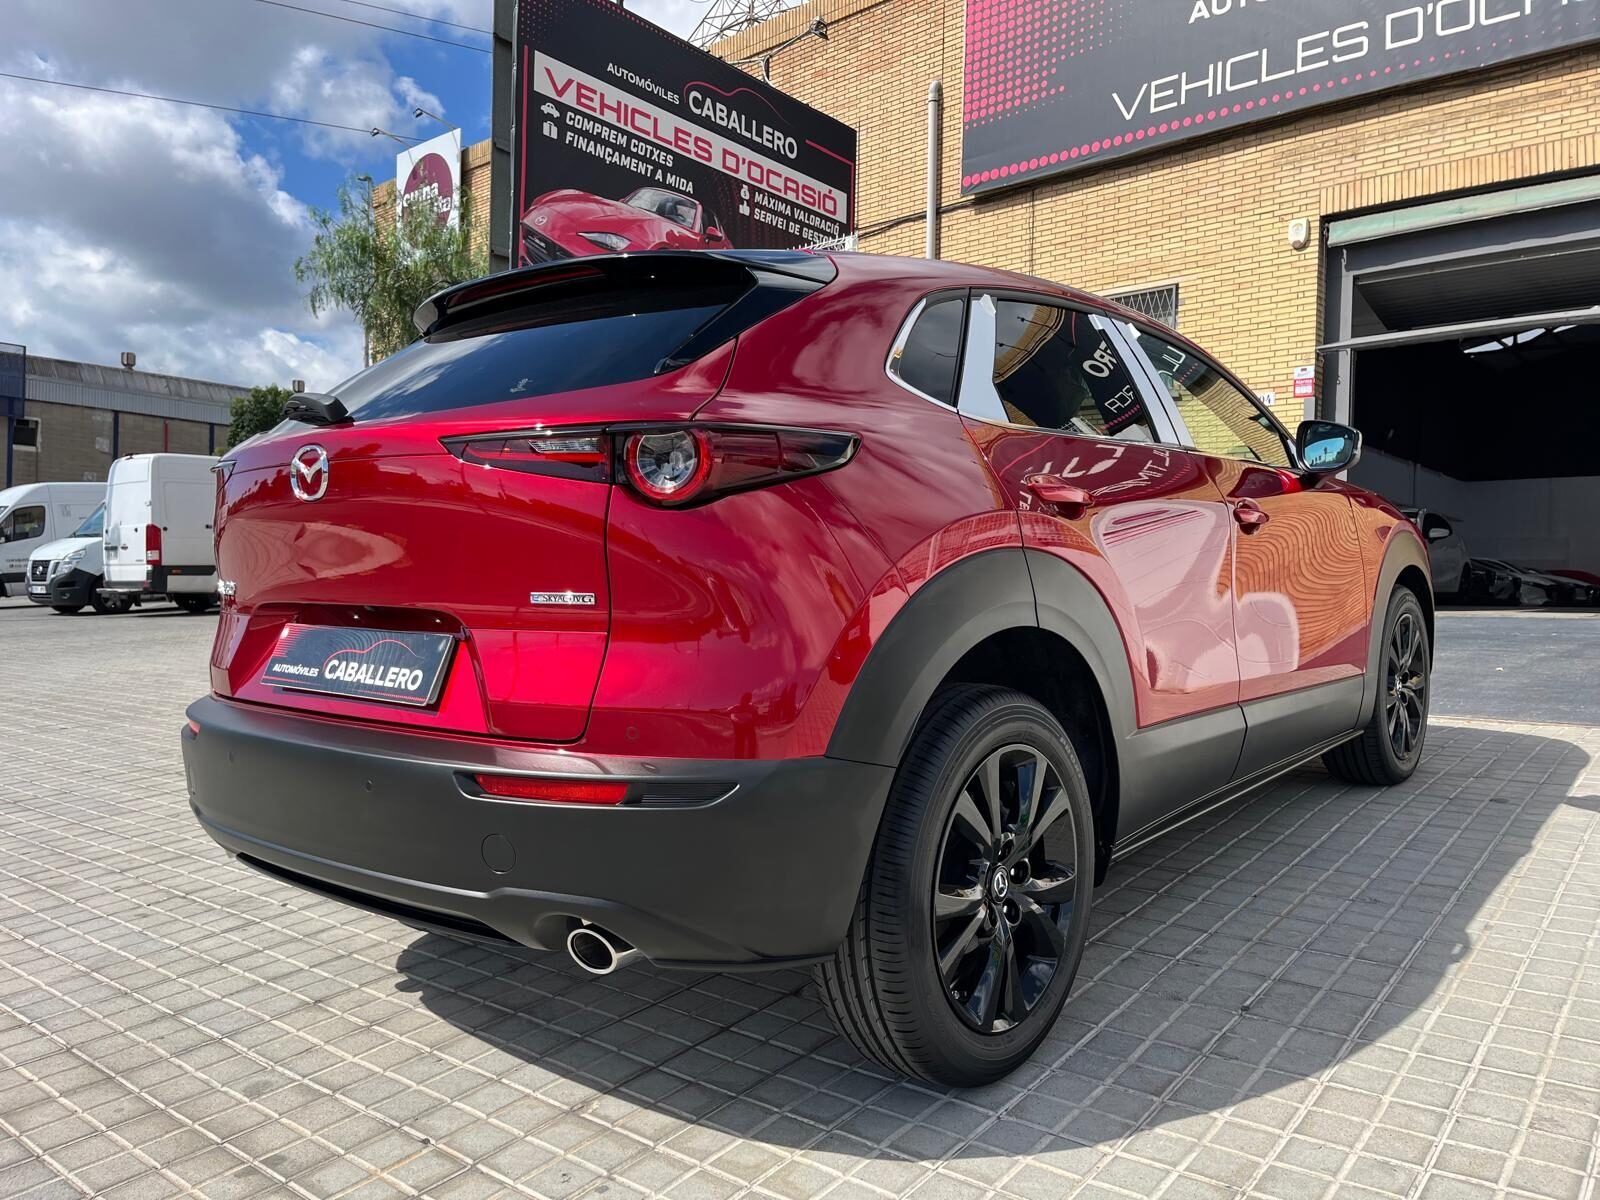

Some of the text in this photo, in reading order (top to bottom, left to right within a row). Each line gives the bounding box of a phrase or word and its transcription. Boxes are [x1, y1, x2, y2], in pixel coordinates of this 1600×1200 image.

[1112, 21, 1369, 122] VEHICLES
[566, 111, 674, 168] COMPREM COTXES
[607, 62, 798, 159] AUTOMÓVILES CABALLERO
[544, 66, 837, 216] VEHICLES D'OCASIÓ
[565, 131, 694, 194] FINANÇAMENT A MIDA
[754, 191, 840, 236] MÀXIMA VALORACIÓ
[754, 208, 786, 231] SERVEI
[788, 221, 801, 236] DE
[272, 659, 424, 691] AUTOMÓVILES CABALLERO
